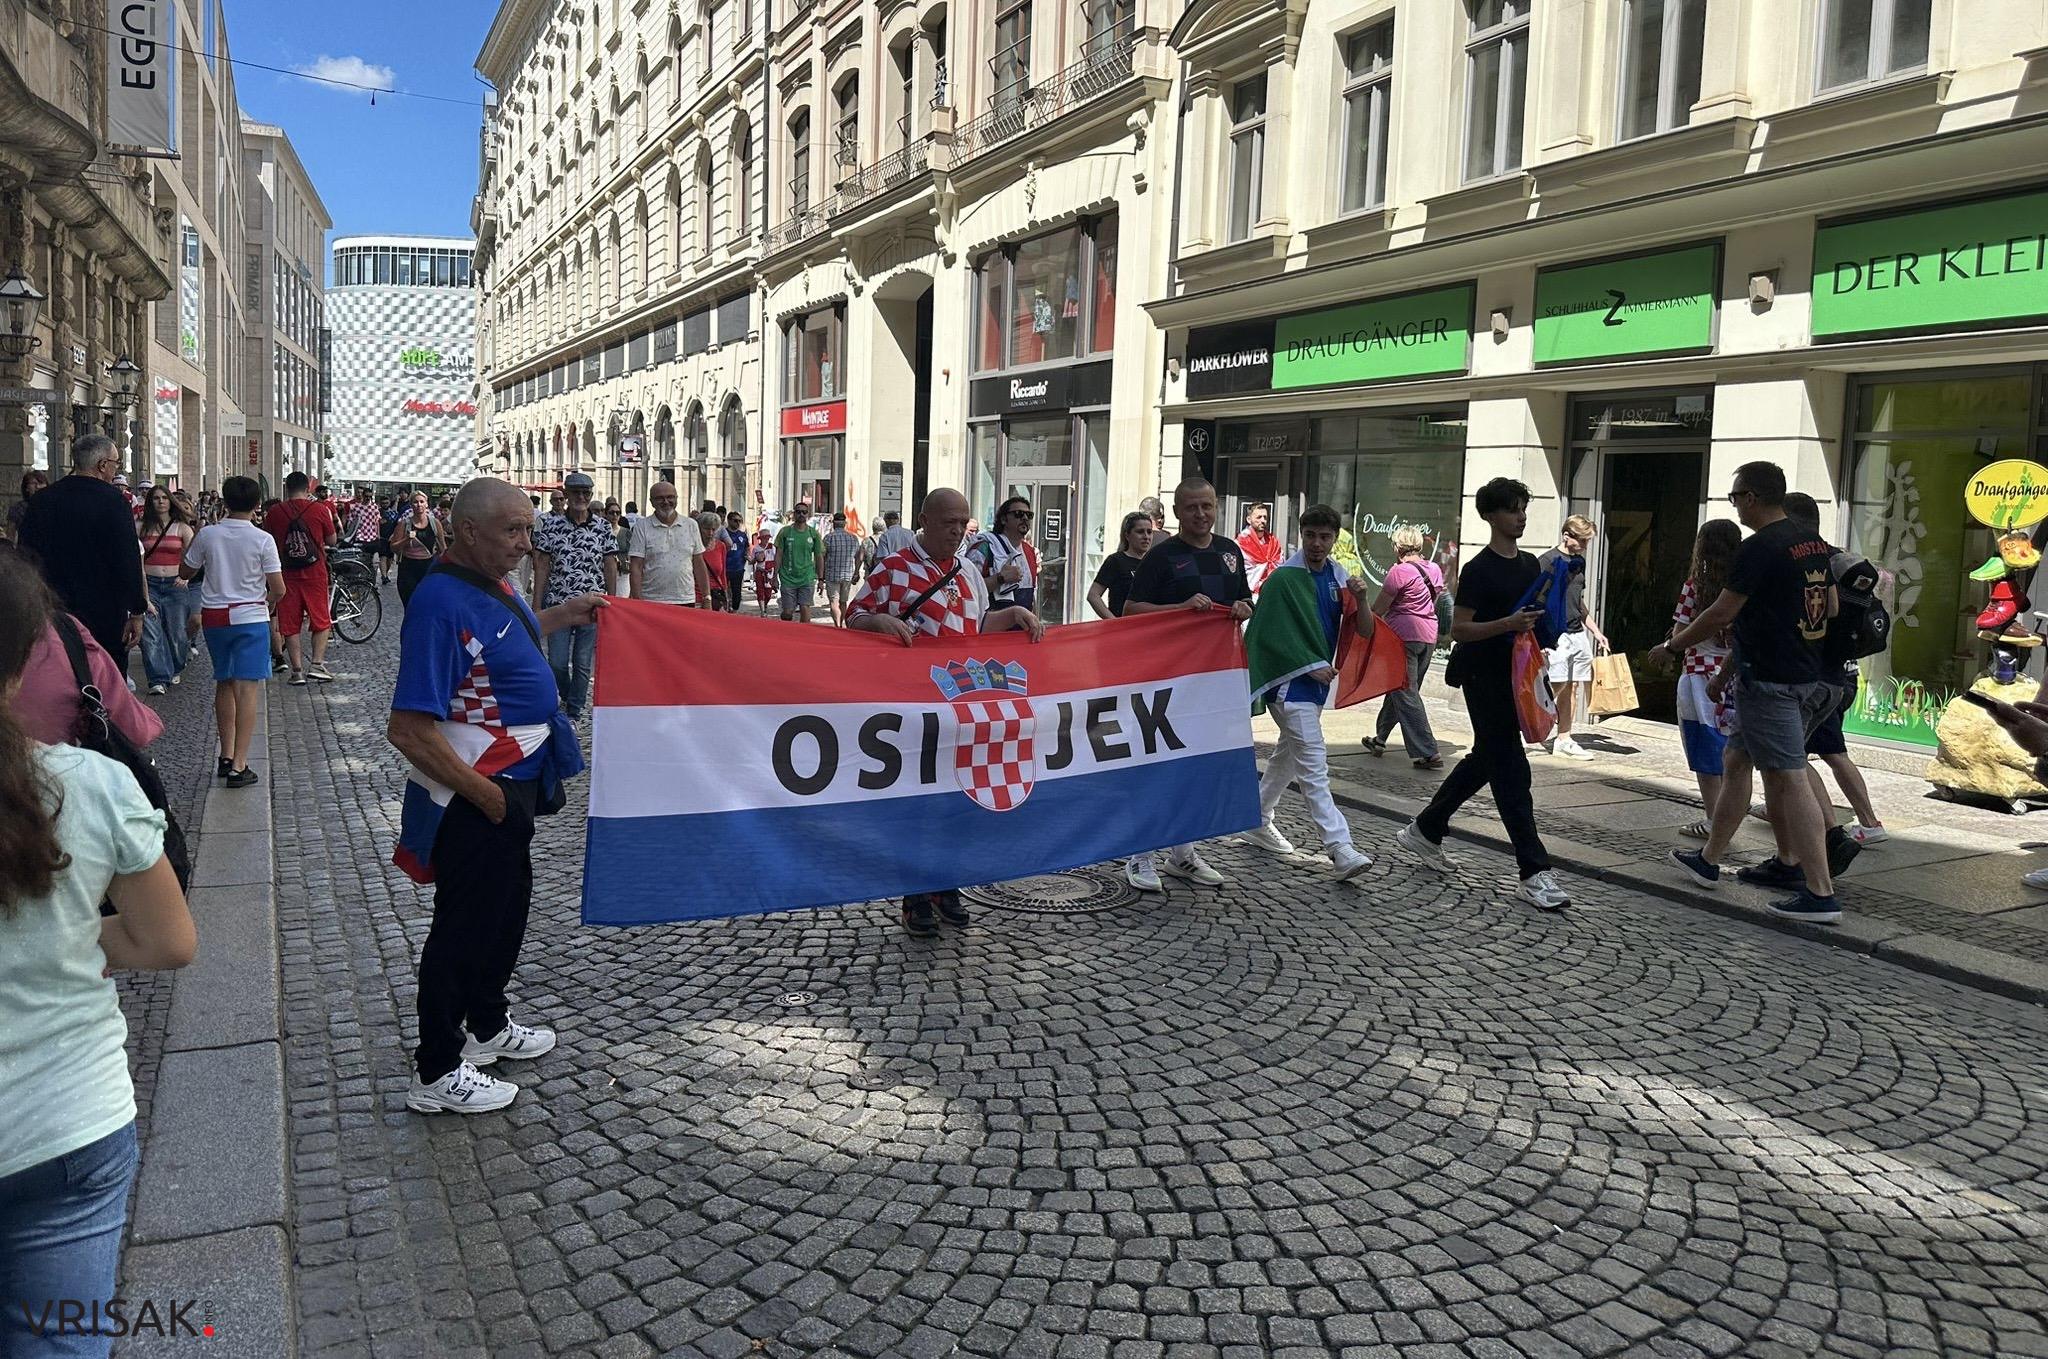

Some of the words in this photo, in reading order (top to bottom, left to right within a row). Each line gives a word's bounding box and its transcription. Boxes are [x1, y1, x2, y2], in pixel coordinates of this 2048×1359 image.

[1832, 252, 1921, 295] DER
[1545, 299, 1609, 317] SCHUHHAUS
[1287, 317, 1449, 363] DRAUFGÄNGER
[1190, 348, 1269, 373] DARKFLOWER
[1621, 408, 1652, 425] 1987
[249, 440, 258, 465] REWE
